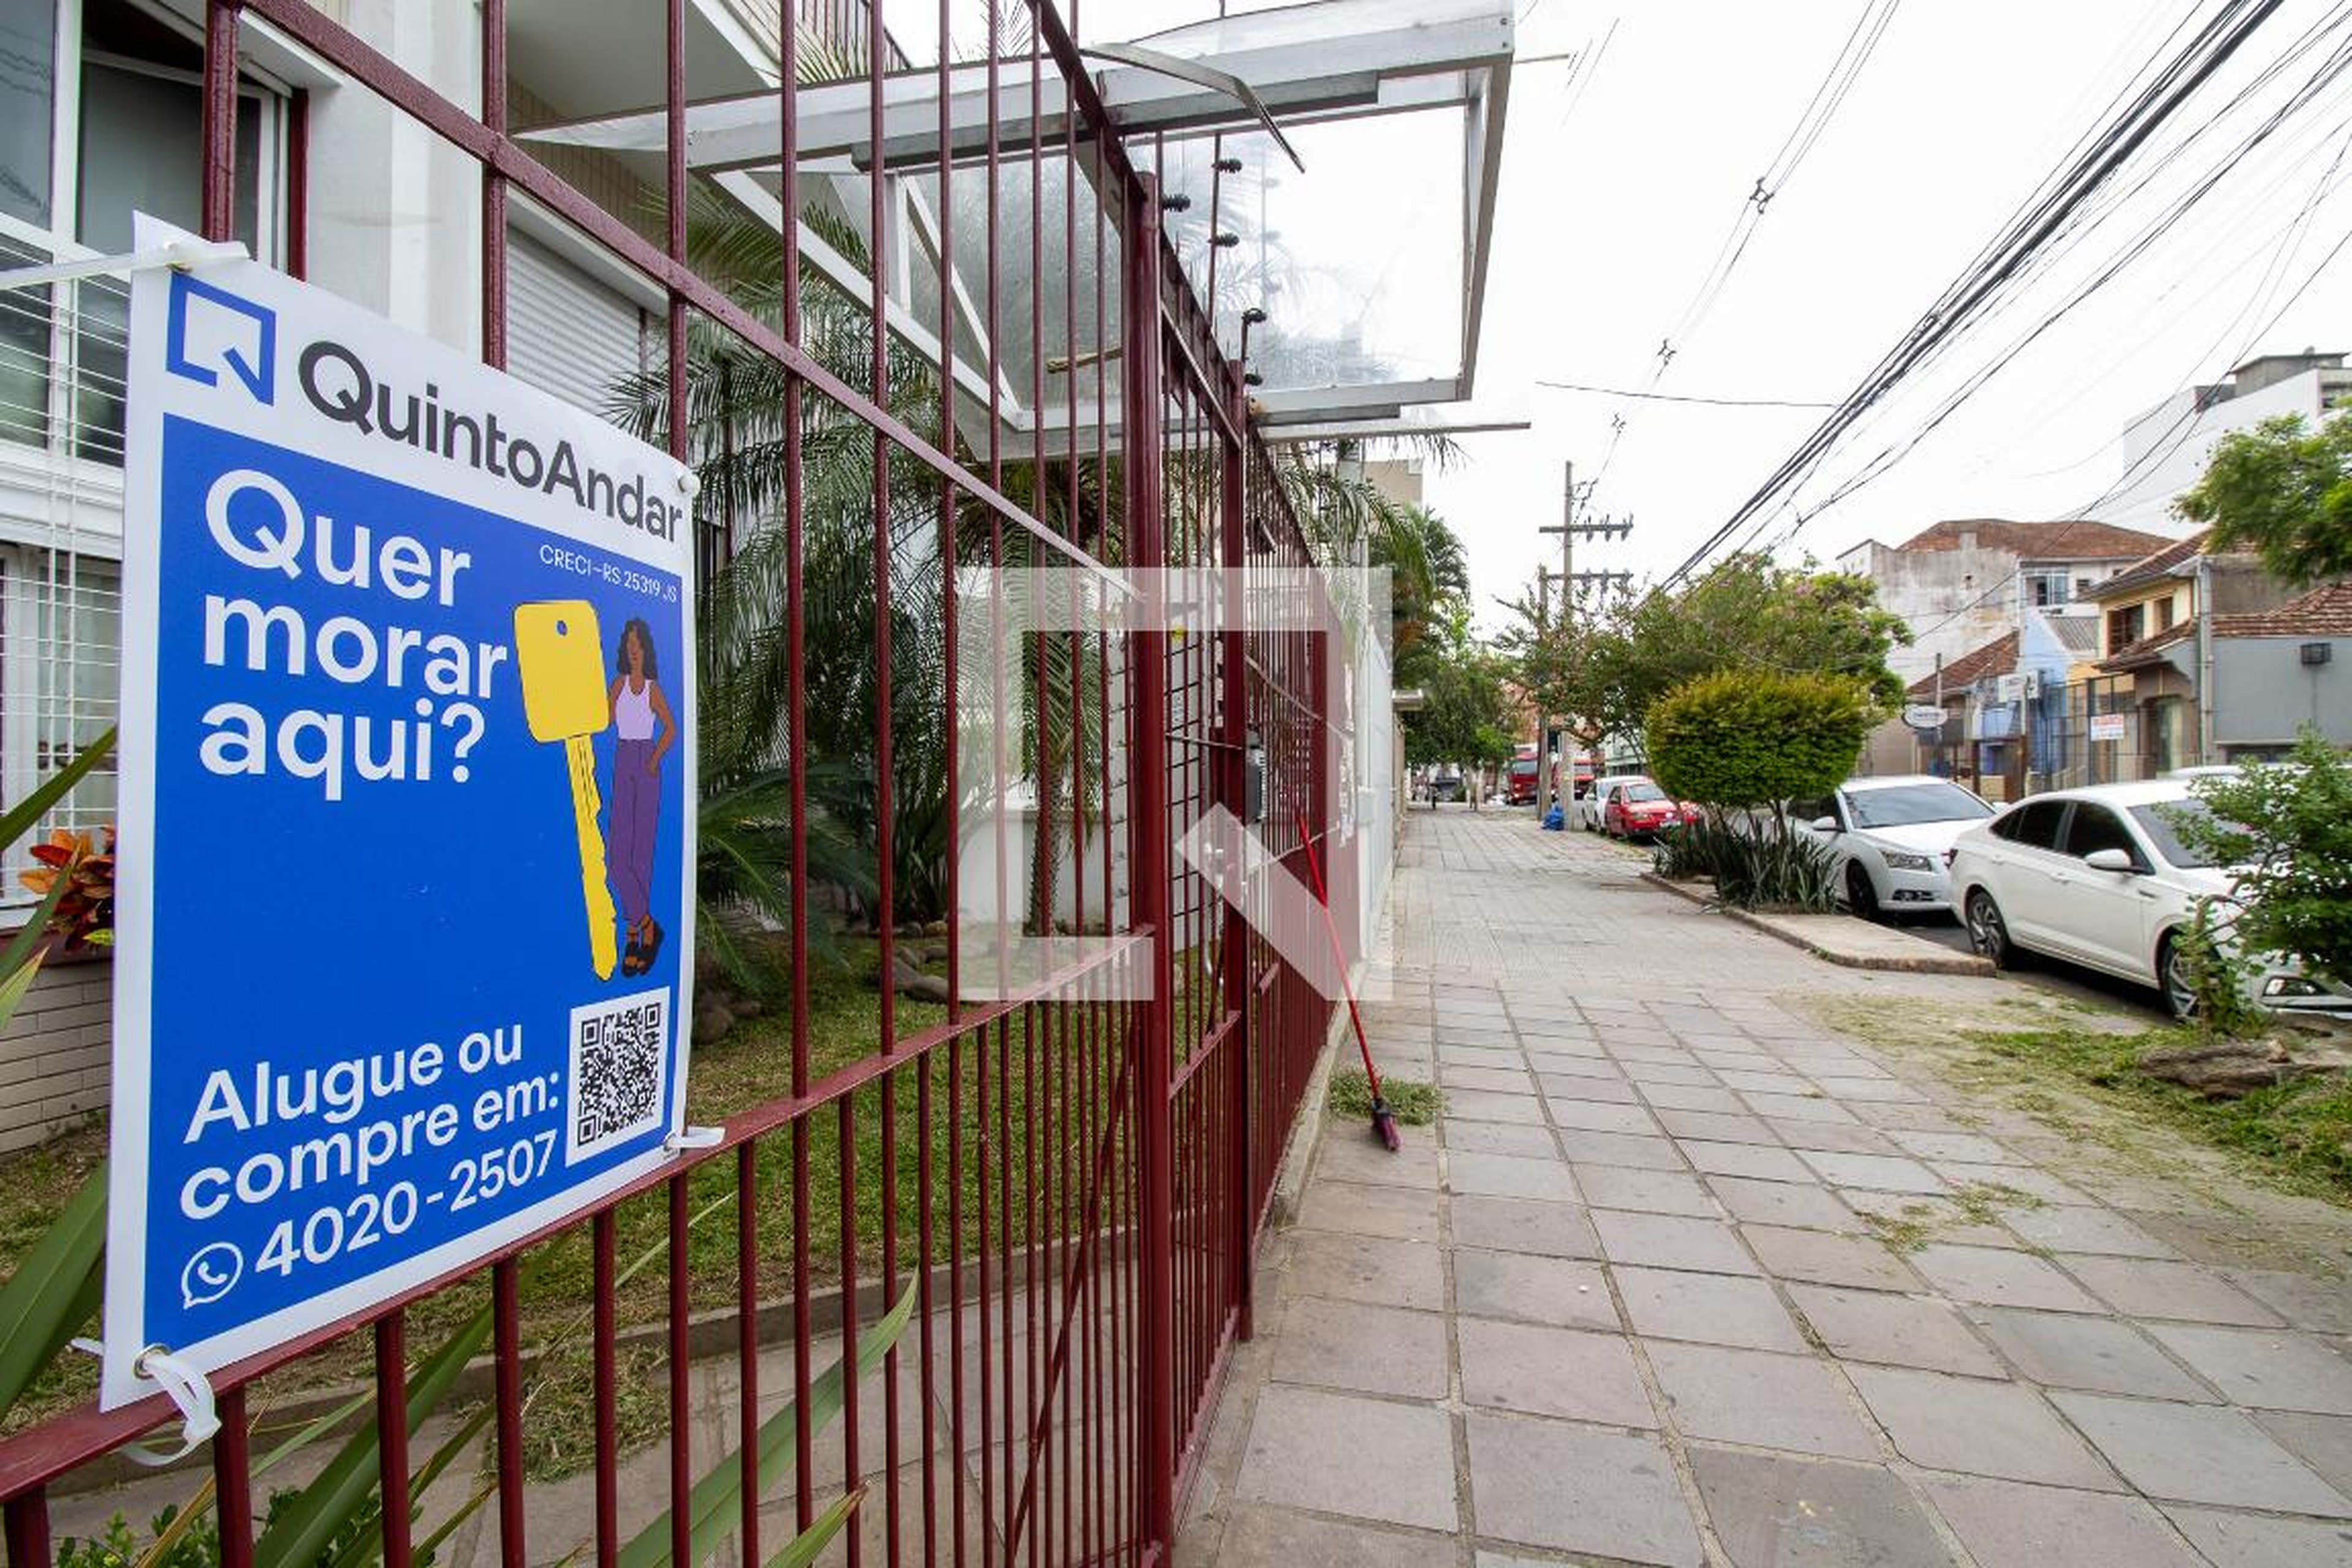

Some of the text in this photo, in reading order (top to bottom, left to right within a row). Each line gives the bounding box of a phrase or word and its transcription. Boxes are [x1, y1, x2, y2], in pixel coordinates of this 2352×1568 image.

[298, 341, 683, 544] QuintoAndar
[205, 468, 472, 606] Quer
[624, 570, 661, 597] 25319
[204, 594, 508, 699] morar
[199, 697, 485, 801] aqui?
[183, 1024, 522, 1144] Alugue ou
[180, 1072, 559, 1219] compre em:
